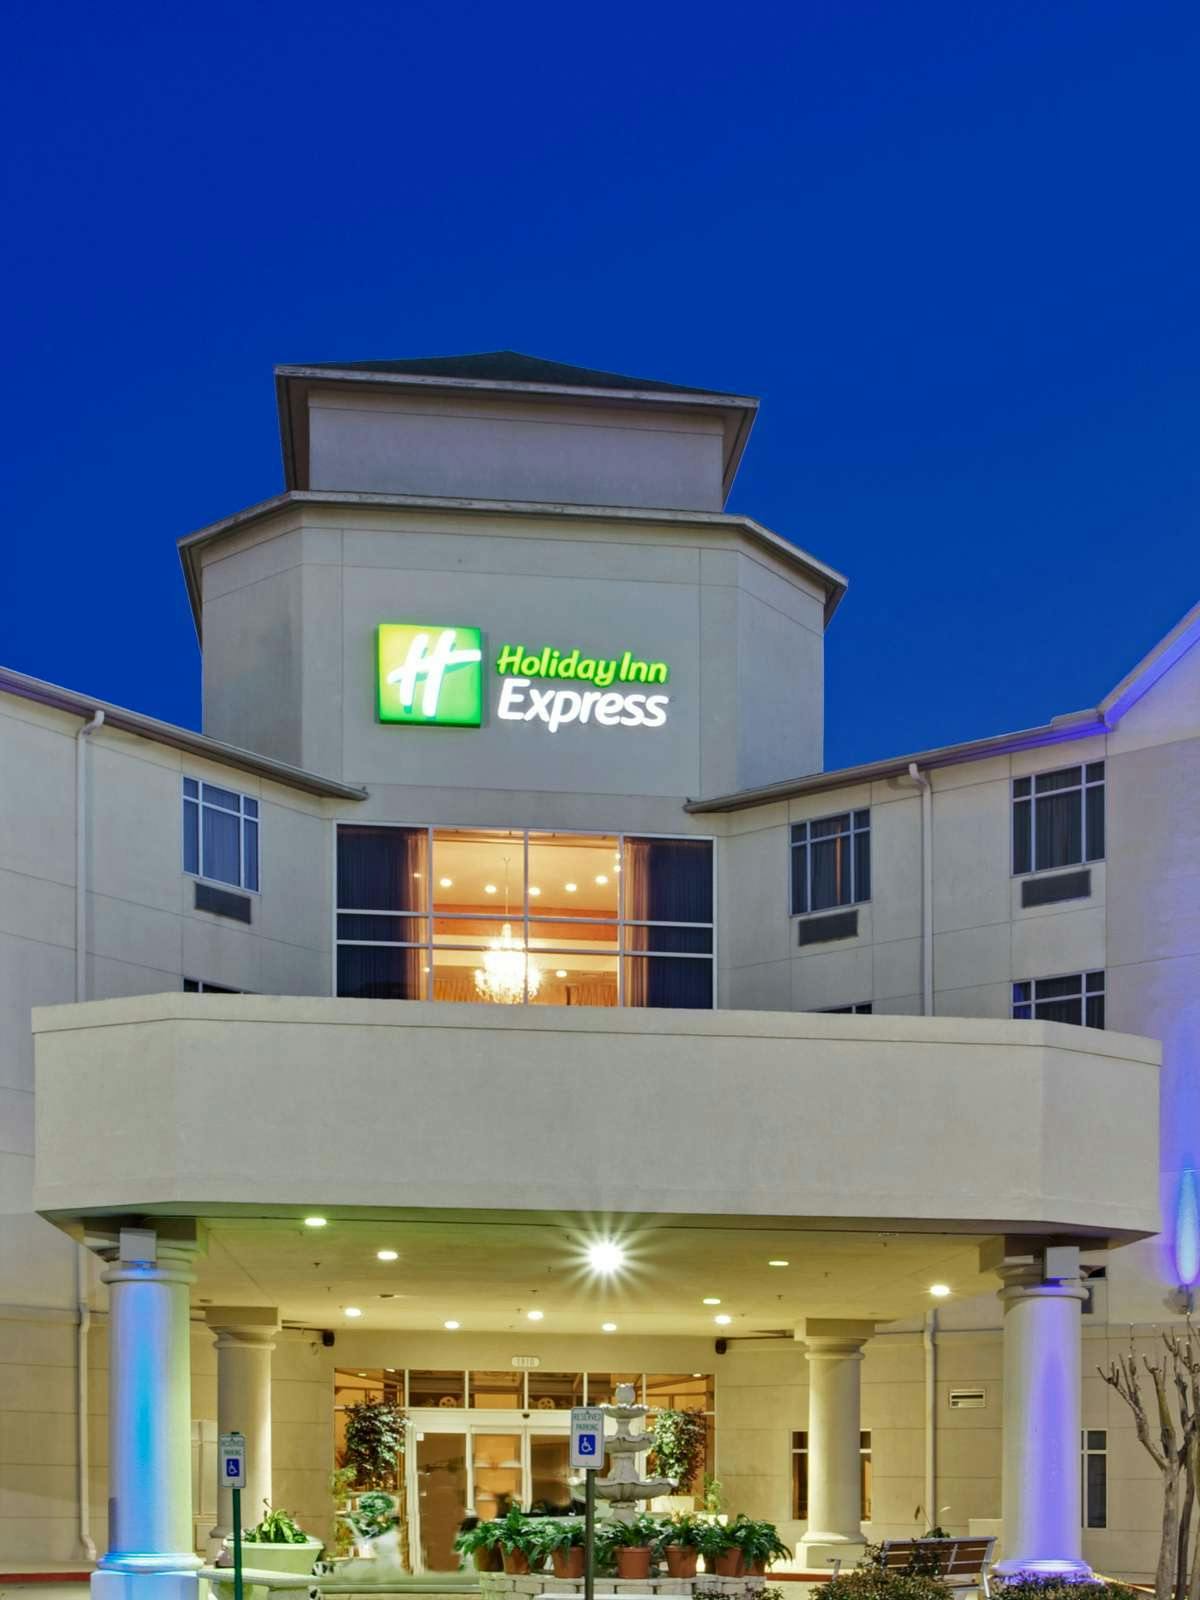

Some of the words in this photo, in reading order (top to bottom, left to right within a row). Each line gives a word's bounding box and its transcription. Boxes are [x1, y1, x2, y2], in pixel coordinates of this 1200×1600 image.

[497, 645, 617, 686] Holiday
[619, 651, 669, 683] Inn
[497, 678, 670, 733] Express
